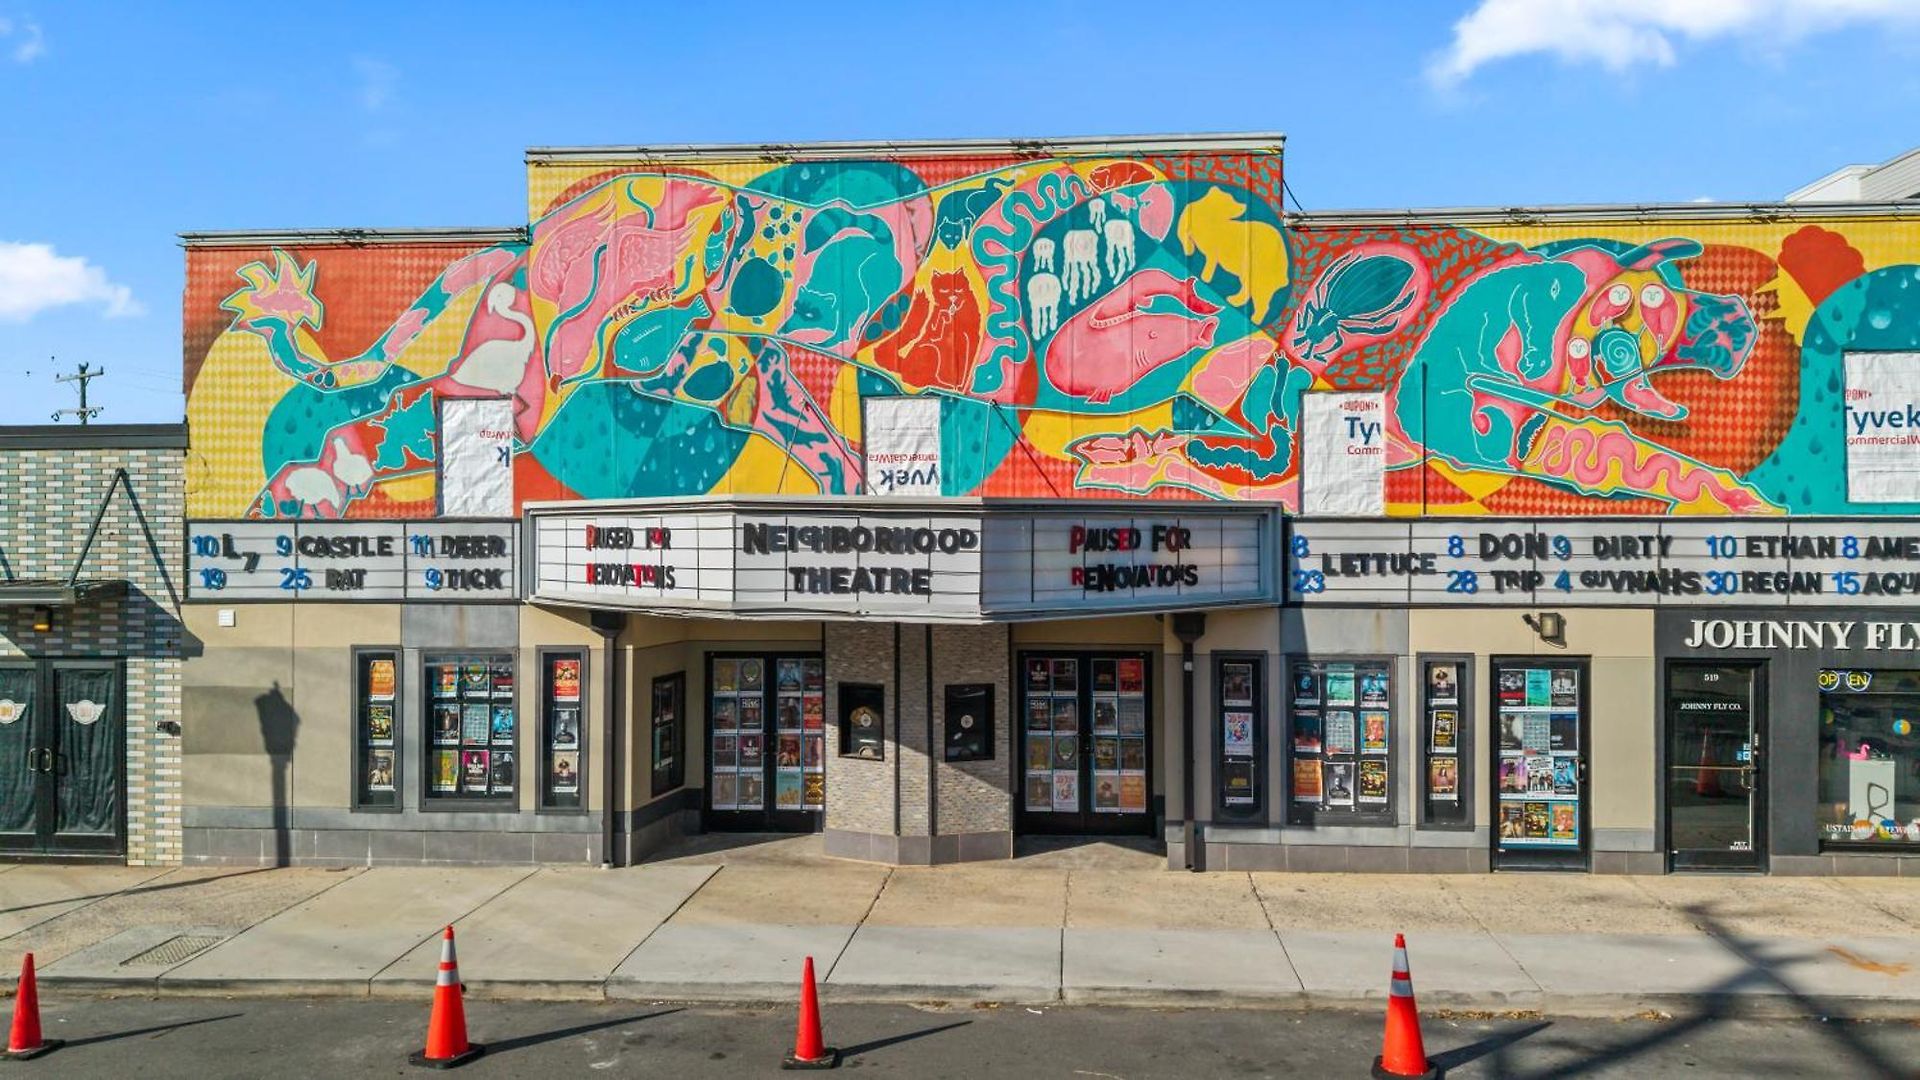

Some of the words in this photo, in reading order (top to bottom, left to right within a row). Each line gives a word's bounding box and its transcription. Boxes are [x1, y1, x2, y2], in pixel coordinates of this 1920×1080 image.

[192, 535, 219, 557] 10
[276, 535, 293, 557] 9
[298, 535, 394, 558] CASTLE
[441, 535, 506, 559] DEER
[586, 524, 634, 551] PAUSED
[645, 527, 671, 551] FOR
[743, 522, 979, 555] NEIGHBORHOOD
[1069, 525, 1141, 554] PAUSED
[1152, 524, 1191, 553] FOR
[1292, 535, 1310, 559] 8
[1448, 535, 1465, 559] 8
[1479, 532, 1549, 561] DON
[1552, 534, 1573, 561] 9
[1593, 535, 1673, 560] DIRTY
[1705, 535, 1738, 559] 10
[1745, 535, 1837, 559] ETHAN
[1842, 535, 1859, 559] 8
[1864, 535, 1920, 560] AME
[1322, 552, 1438, 577] LETTUCE
[200, 568, 227, 590] 19
[280, 568, 313, 590] 25
[444, 568, 504, 591] TICK
[788, 566, 932, 595] THEATRE
[1071, 563, 1198, 592] RENOVATIONS
[1293, 569, 1326, 593] 23
[1447, 569, 1479, 594] 28
[1491, 569, 1546, 593] TRIP
[1553, 569, 1574, 593] 4
[1580, 568, 1701, 595] GUVNAHS
[1705, 570, 1738, 595] 30
[1741, 570, 1823, 595] REGAN
[1832, 571, 1861, 595] 15
[1684, 619, 1857, 651] JOHNNY
[1704, 673, 1719, 682] 519
[1680, 702, 1712, 711] JOHNNY
[1713, 702, 1728, 710] FLY
